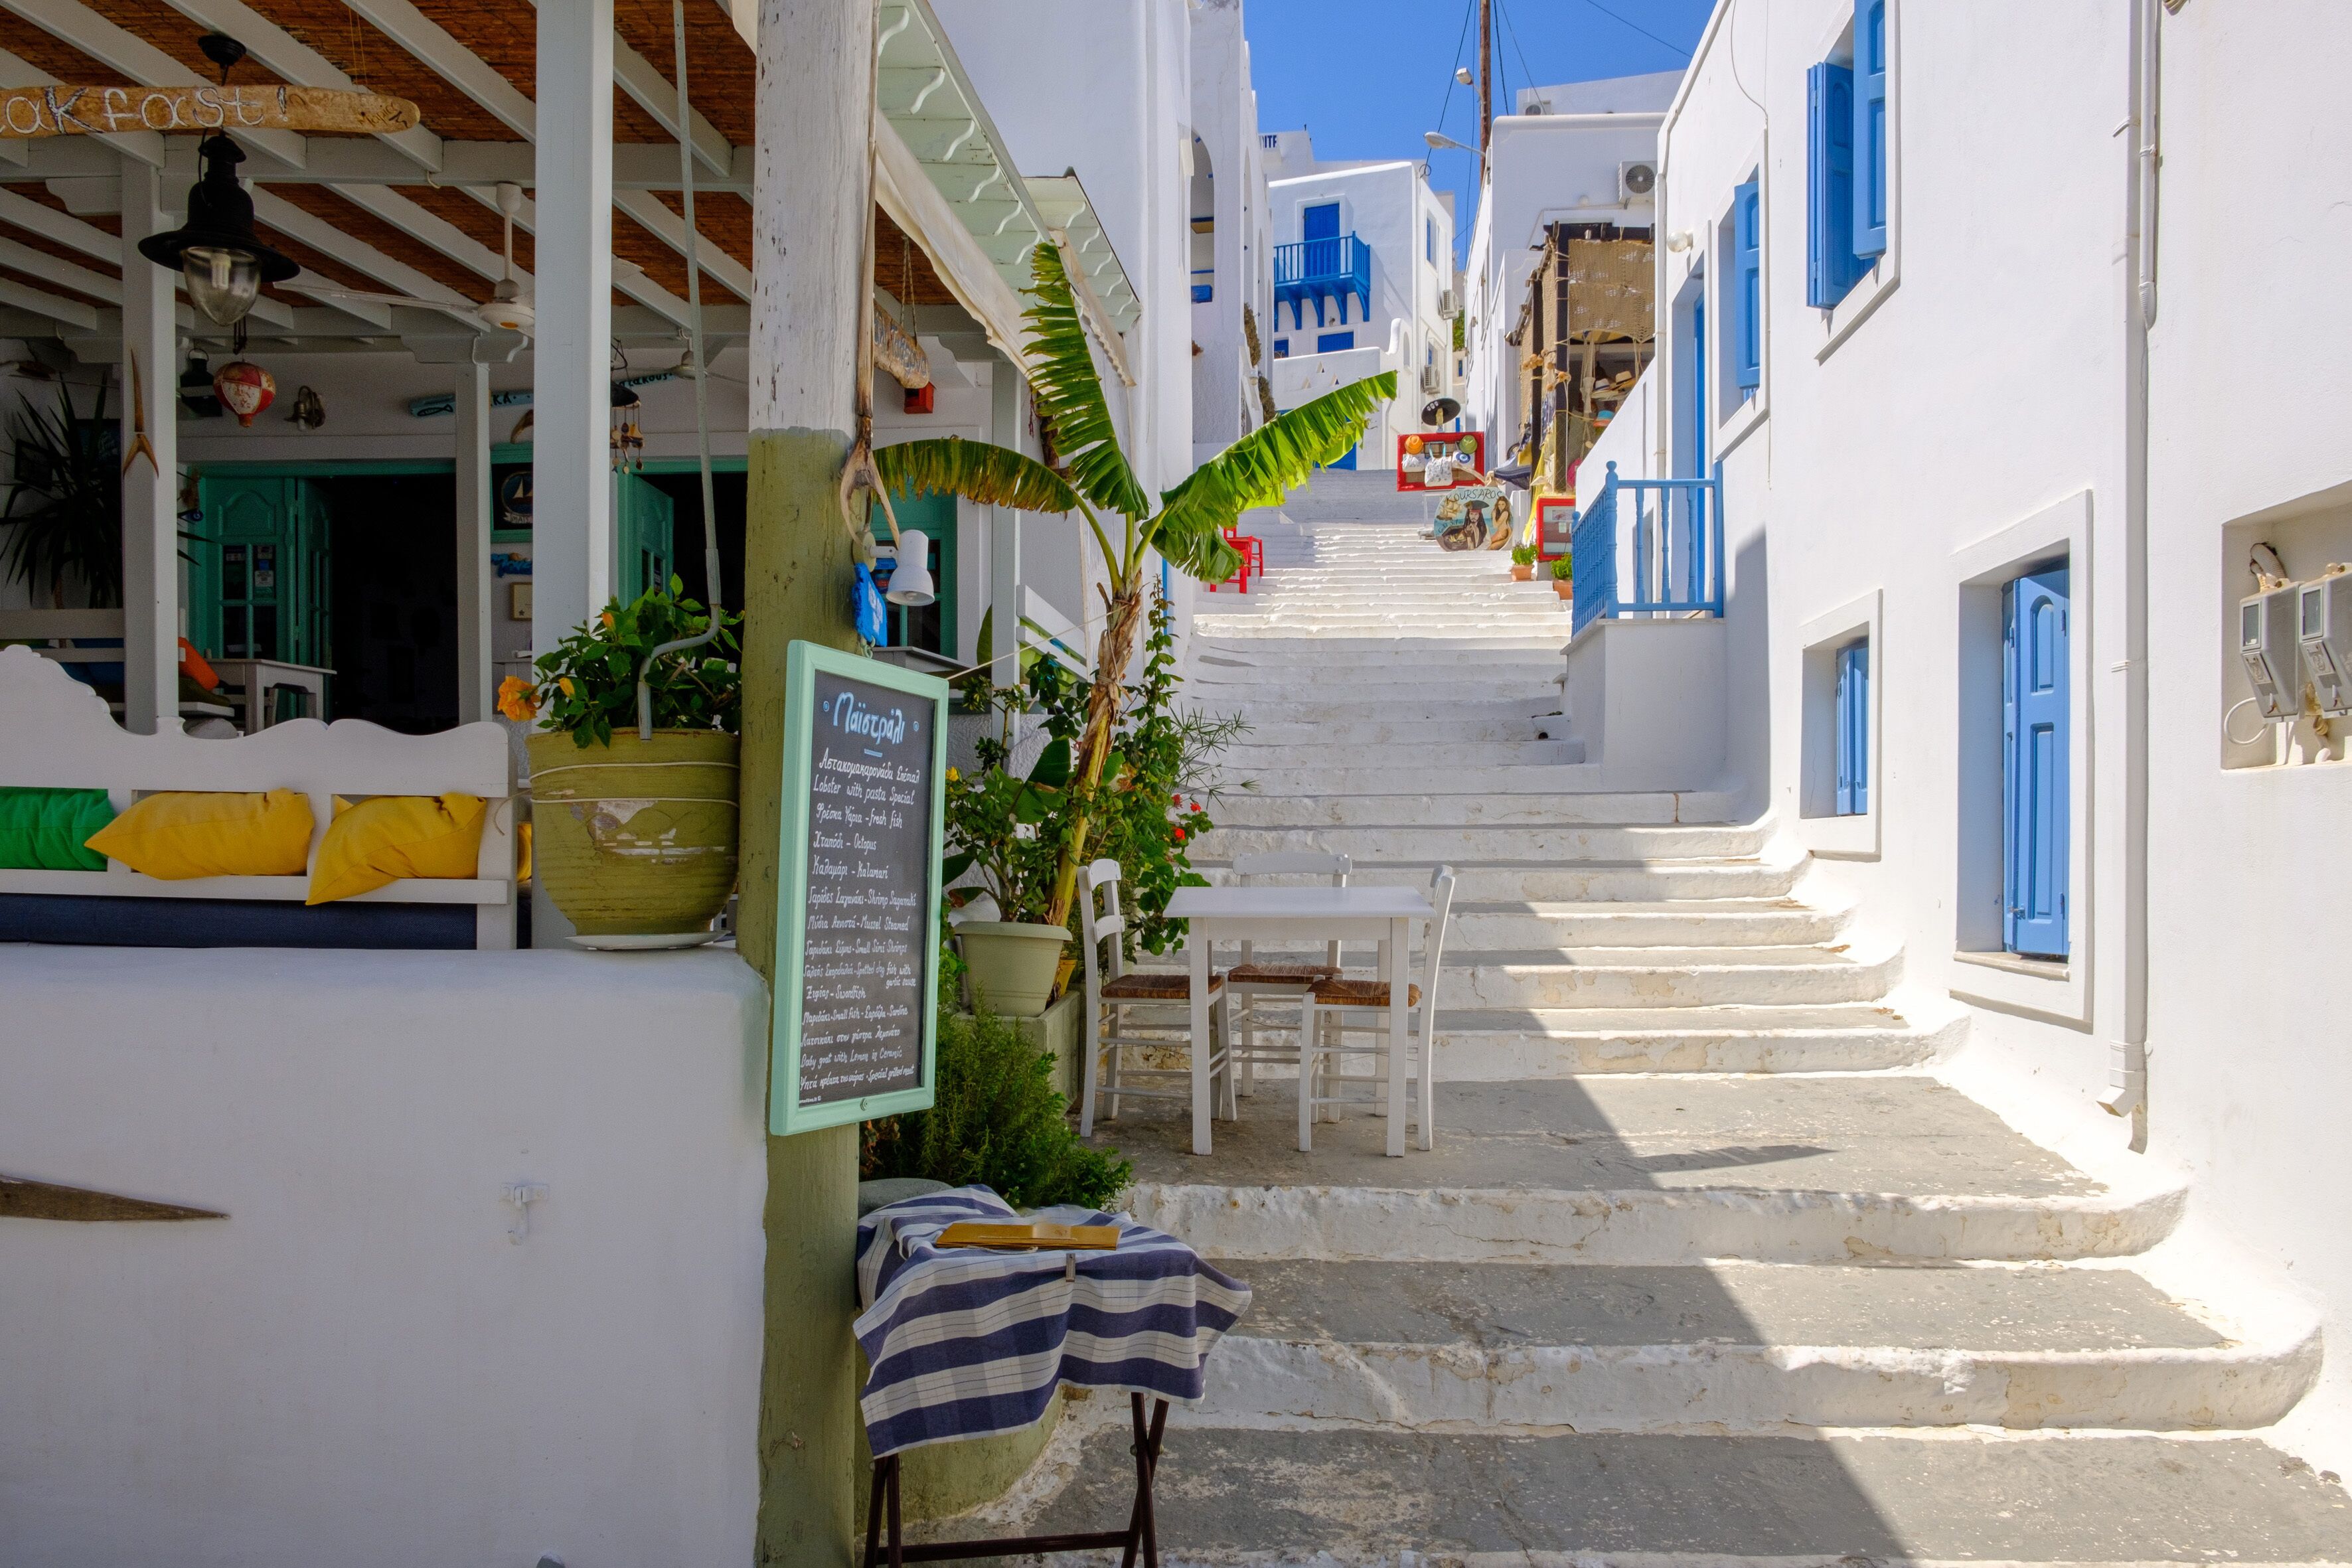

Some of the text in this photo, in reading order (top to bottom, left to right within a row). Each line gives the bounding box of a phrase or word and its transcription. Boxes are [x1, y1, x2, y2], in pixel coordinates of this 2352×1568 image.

[813, 774, 915, 806] Lobster with pasta Special
[890, 810, 903, 829] fish
[854, 833, 877, 855] Octopus
[857, 860, 888, 879] Kalamari
[884, 916, 910, 931] Steamed
